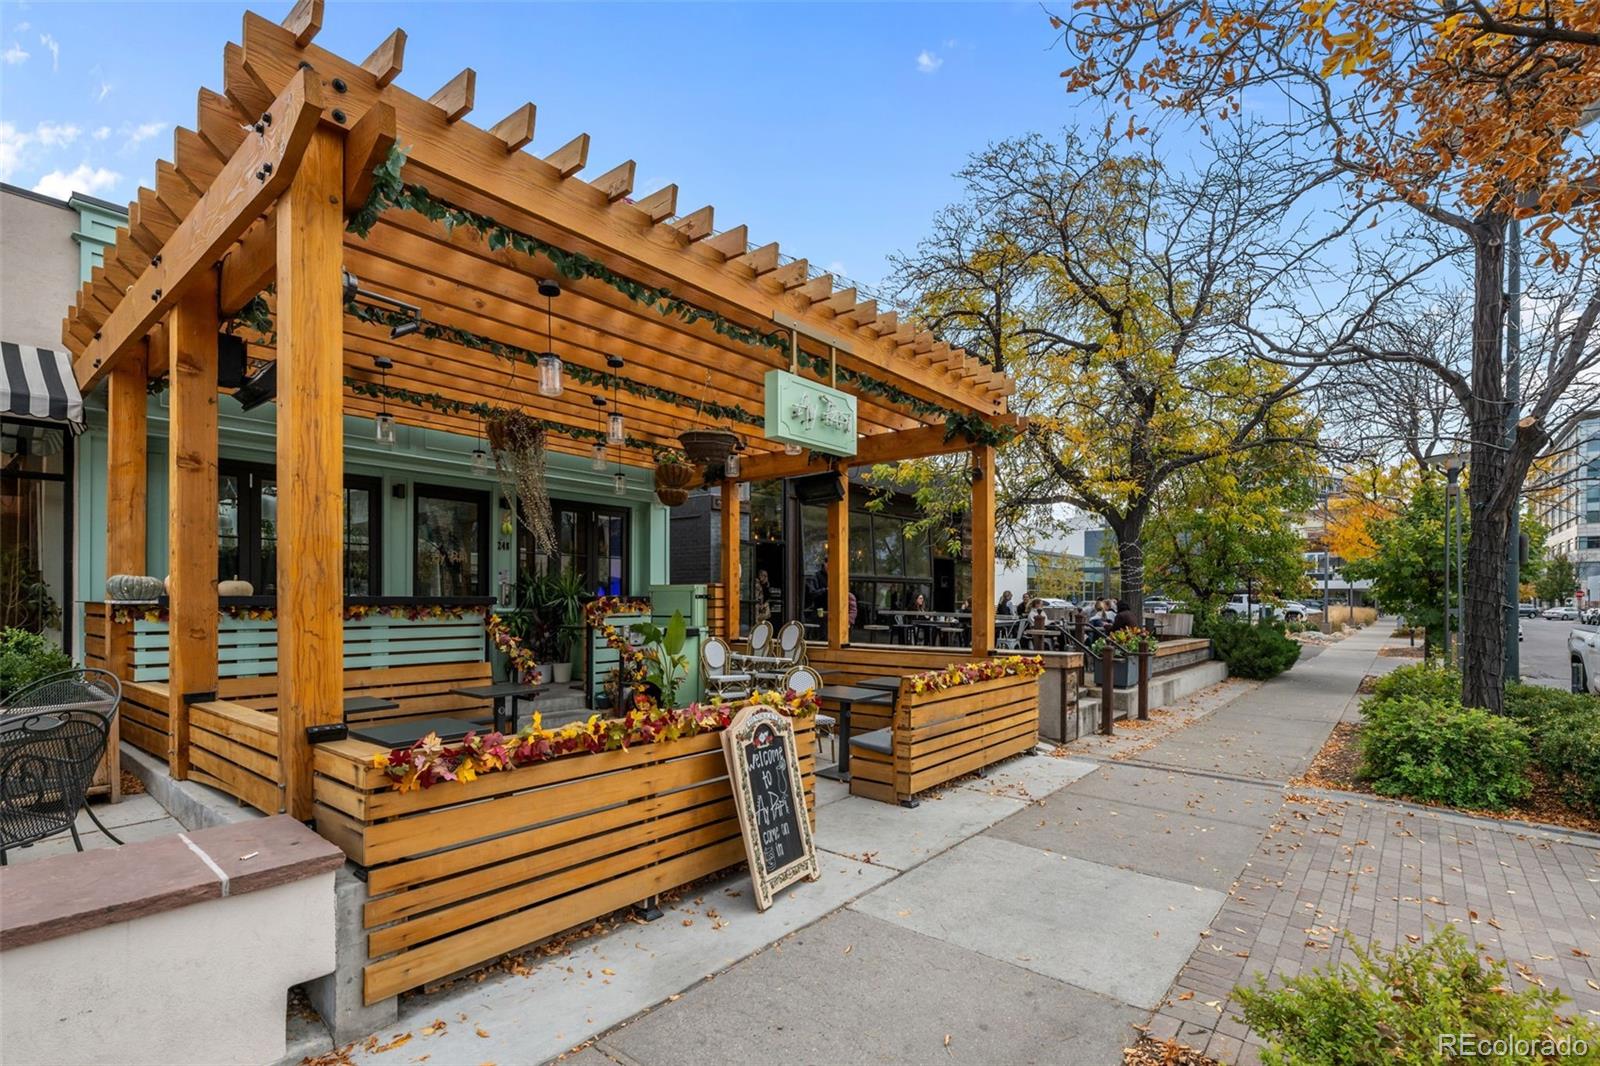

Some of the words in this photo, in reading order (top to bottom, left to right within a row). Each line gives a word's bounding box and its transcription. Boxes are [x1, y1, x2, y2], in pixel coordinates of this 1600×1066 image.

[762, 770, 772, 789] to
[762, 826, 780, 846] come
[774, 842, 785, 857] in
